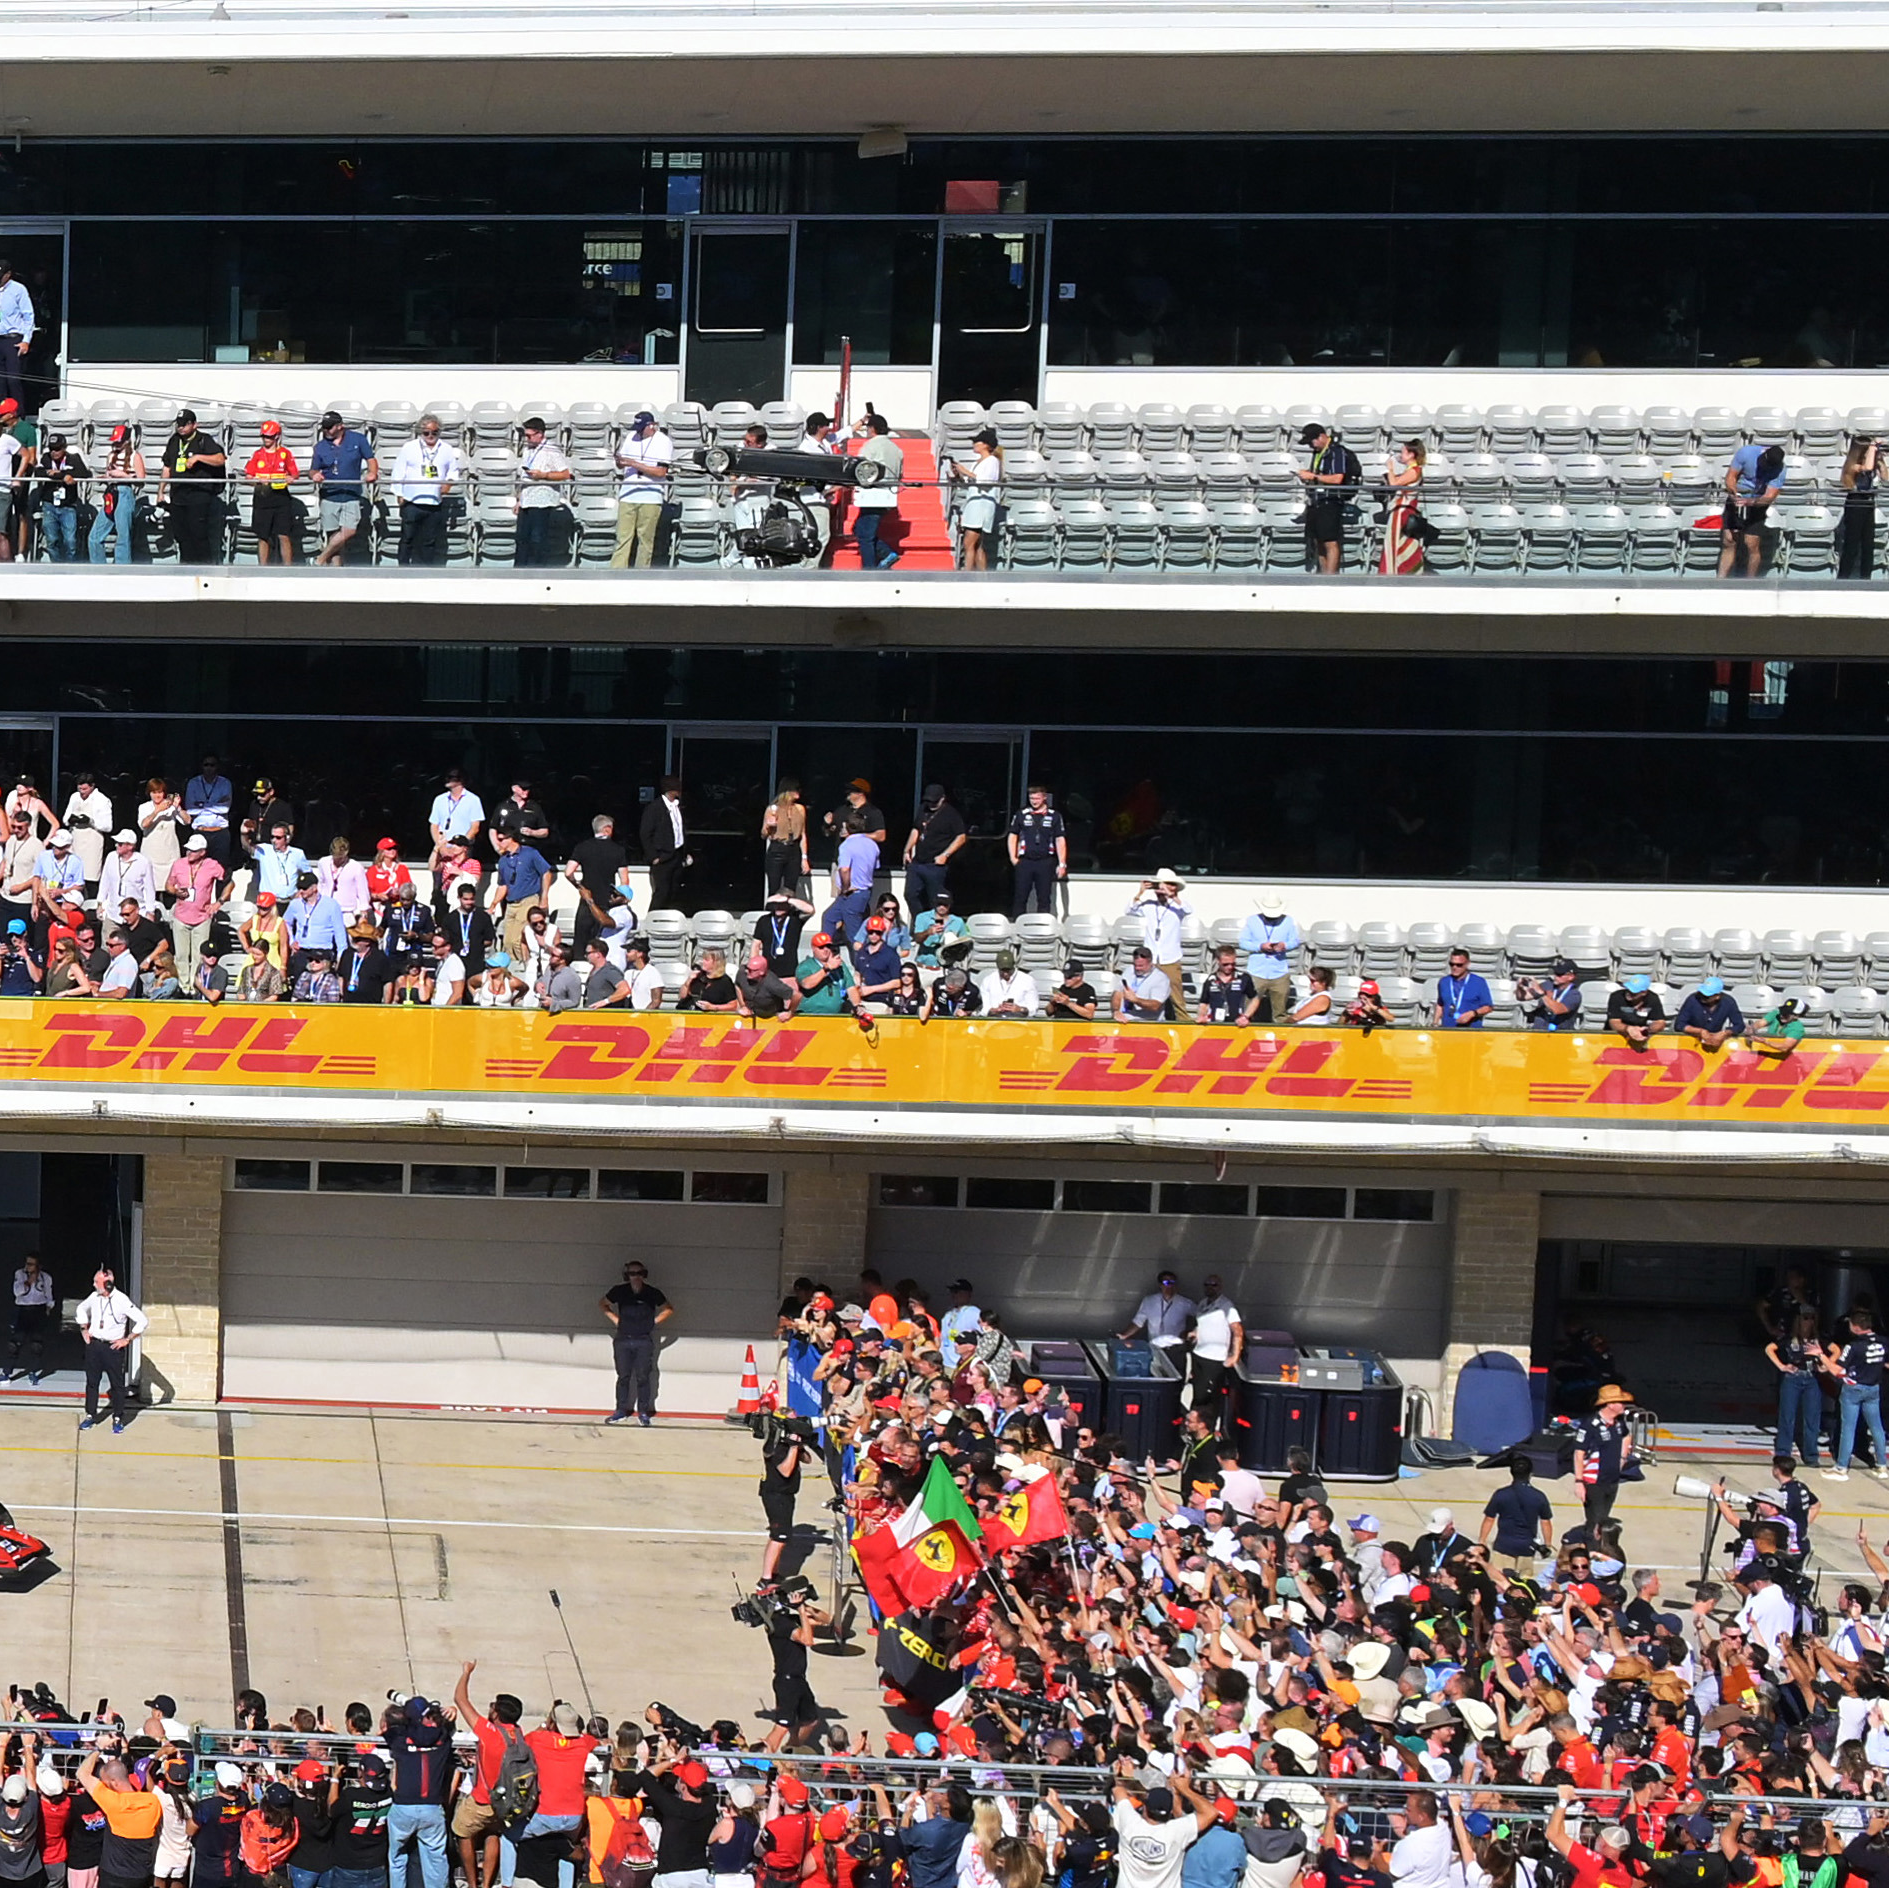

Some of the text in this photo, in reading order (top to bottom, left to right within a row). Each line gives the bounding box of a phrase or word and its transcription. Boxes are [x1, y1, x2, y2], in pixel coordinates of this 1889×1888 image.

[38, 1014, 324, 1073] DHL
[539, 1025, 833, 1085] DHL
[1055, 1036, 1357, 1097] DHL
[1586, 1048, 1889, 1110] DHL
[899, 1626, 947, 1671] ZERO
